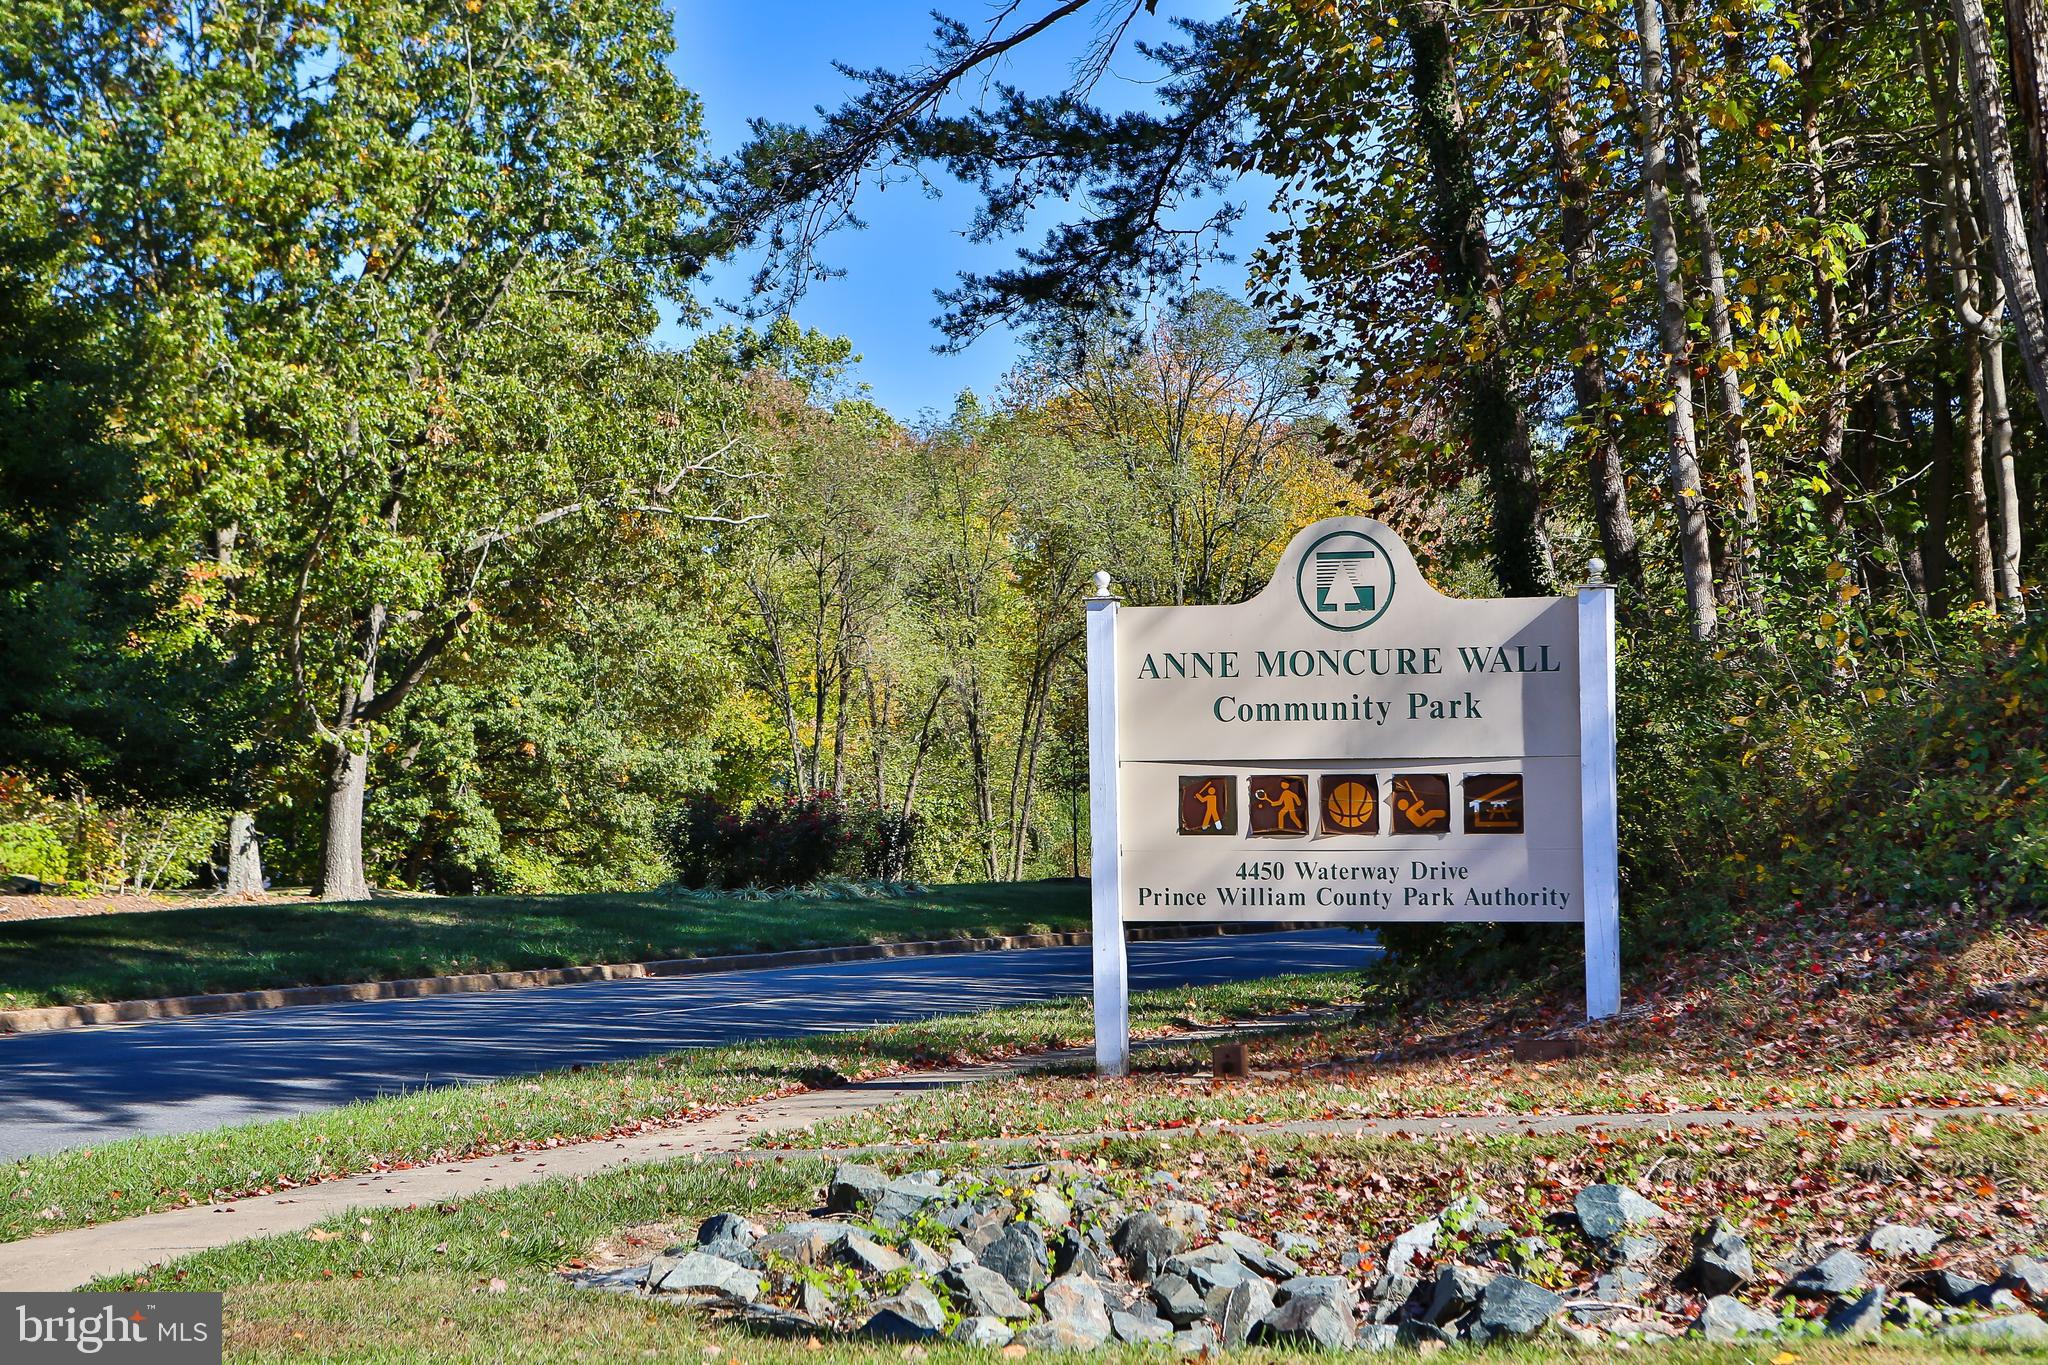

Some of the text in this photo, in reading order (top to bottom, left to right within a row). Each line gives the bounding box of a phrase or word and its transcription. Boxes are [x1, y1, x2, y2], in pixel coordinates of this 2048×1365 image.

[1137, 645, 1561, 679] ANNE MONCURE WALL
[1213, 692, 1483, 726] Community Park
[1235, 861, 1469, 884] 4450 Waterway Drive
[1138, 887, 1570, 910] Prince William County Park Authority
